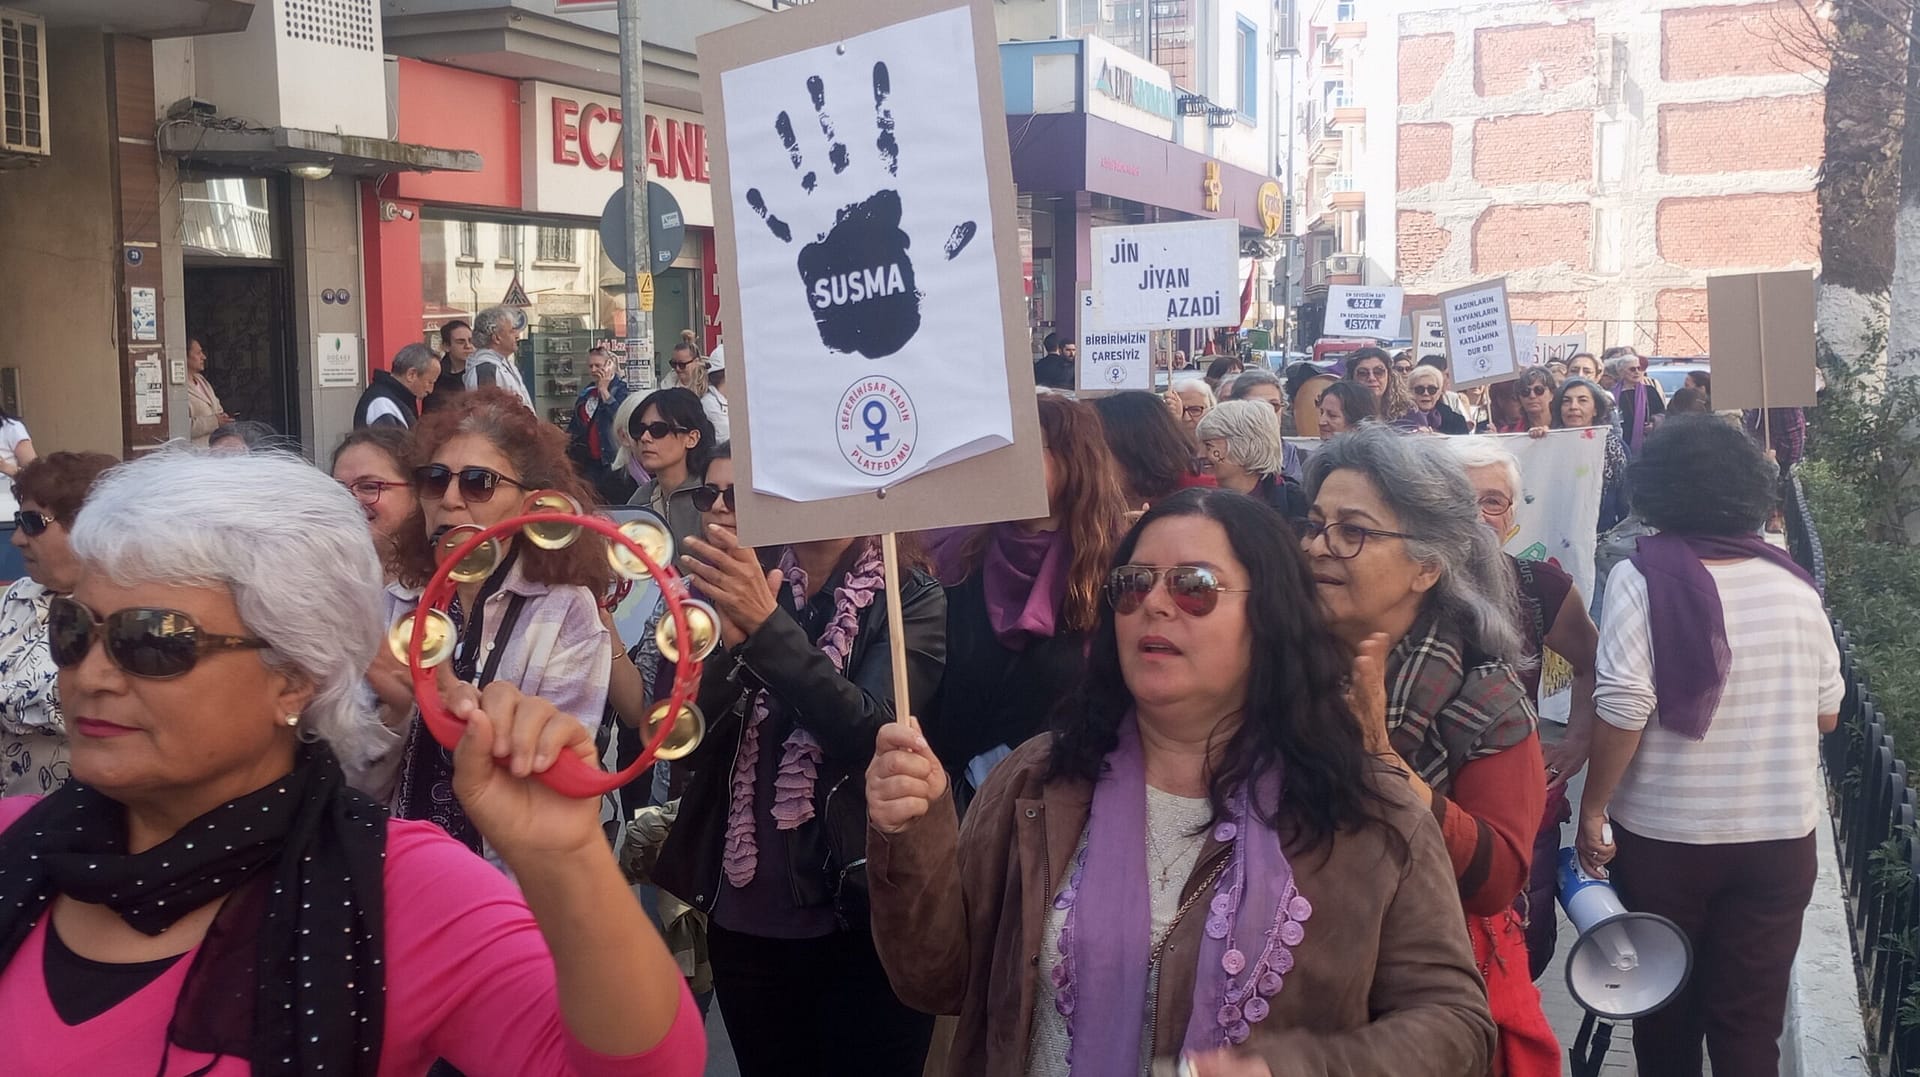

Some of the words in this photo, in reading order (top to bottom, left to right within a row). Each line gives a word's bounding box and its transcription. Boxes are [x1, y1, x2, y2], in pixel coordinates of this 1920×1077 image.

[1110, 238, 1139, 264] JİN
[1138, 264, 1190, 290] JİYAN
[814, 263, 906, 308] SUSMA
[1167, 290, 1220, 318] AZADİ
[1353, 299, 1376, 308] 6284
[1454, 296, 1494, 311] KADINLARIN
[1453, 307, 1499, 323] HAYVANLARIN
[1457, 325, 1466, 335] VE
[1467, 319, 1497, 333] DOĞANIN
[1085, 331, 1146, 346] BİRBİRİMİZİN
[1459, 331, 1499, 346] KATLİAMINA
[1092, 348, 1141, 363] ÇARESİYİZ
[1467, 347, 1481, 356] DUR
[889, 388, 910, 422] KADIN
[851, 443, 911, 471] PLATFORMU
